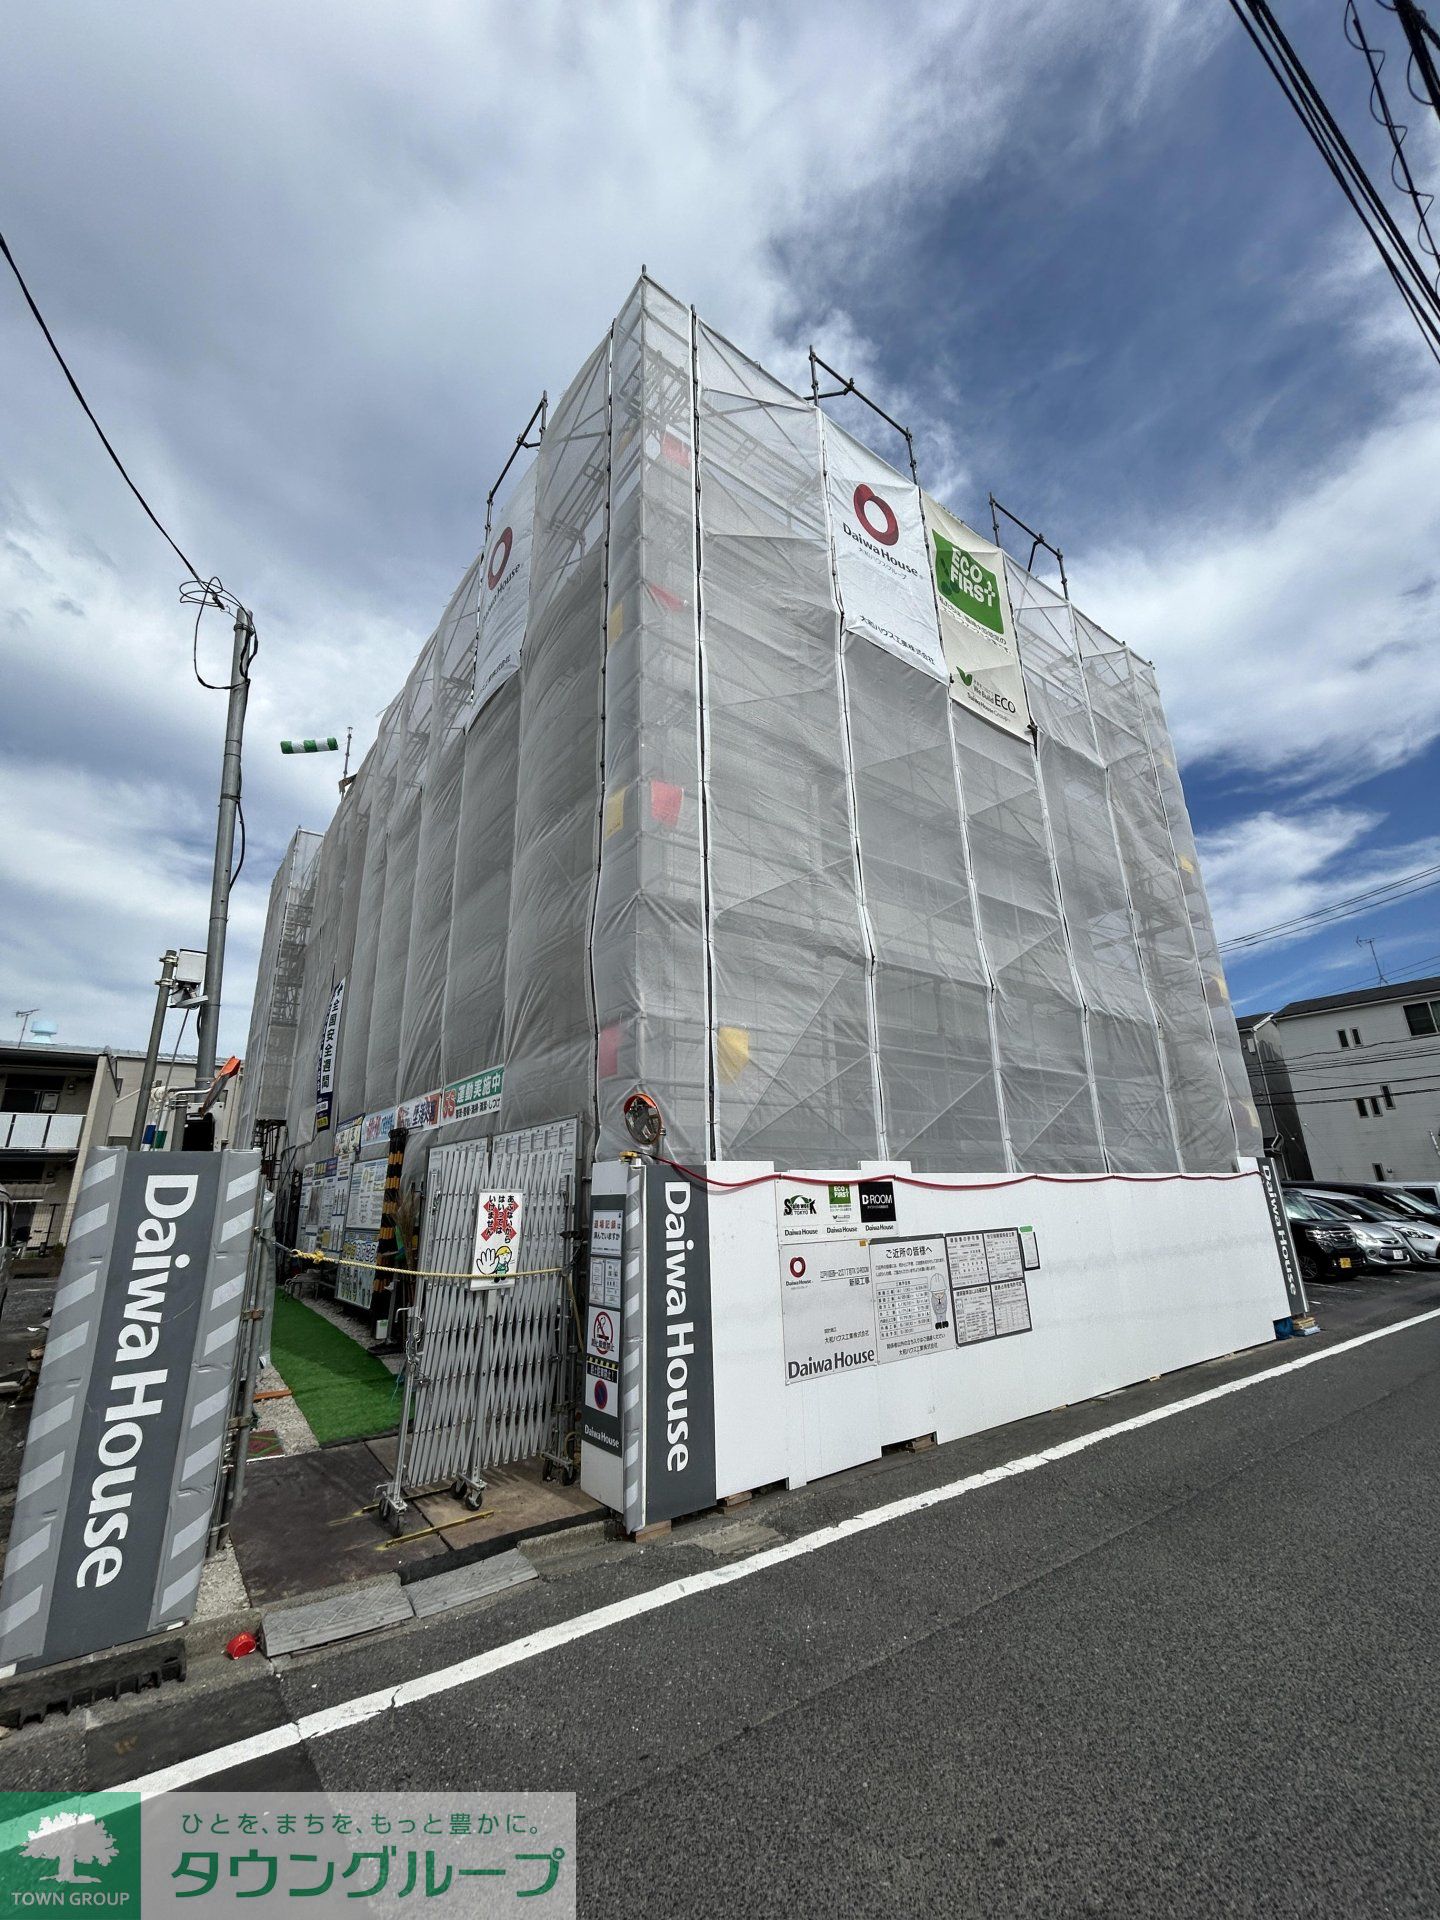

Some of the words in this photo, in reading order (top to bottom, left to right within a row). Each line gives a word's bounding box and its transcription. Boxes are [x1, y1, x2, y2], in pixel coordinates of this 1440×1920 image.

[843, 522, 881, 556] Daiwa
[880, 547, 919, 577] House
[952, 545, 983, 584] ECO
[497, 562, 521, 596] House
[950, 567, 996, 608] FIRST
[994, 693, 1016, 714] ECO
[321, 998, 340, 1089] 全国安全週間
[834, 1189, 849, 1198] FIRST
[486, 1194, 497, 1237] いけません
[495, 1195, 506, 1235] はいっては
[784, 1228, 801, 1237] Daiwa
[1262, 1165, 1282, 1227] Daiwa
[1278, 1230, 1297, 1296] House
[115, 1174, 198, 1363] Daiwa
[665, 1181, 695, 1316] Daiwa
[885, 1246, 933, 1259] ご近所の皆様へ
[788, 1356, 833, 1379] Daiwa
[833, 1350, 875, 1370] House
[666, 1321, 695, 1472] House
[584, 1423, 601, 1440] Daiwa
[600, 1431, 620, 1449] House
[76, 1368, 168, 1589] House
